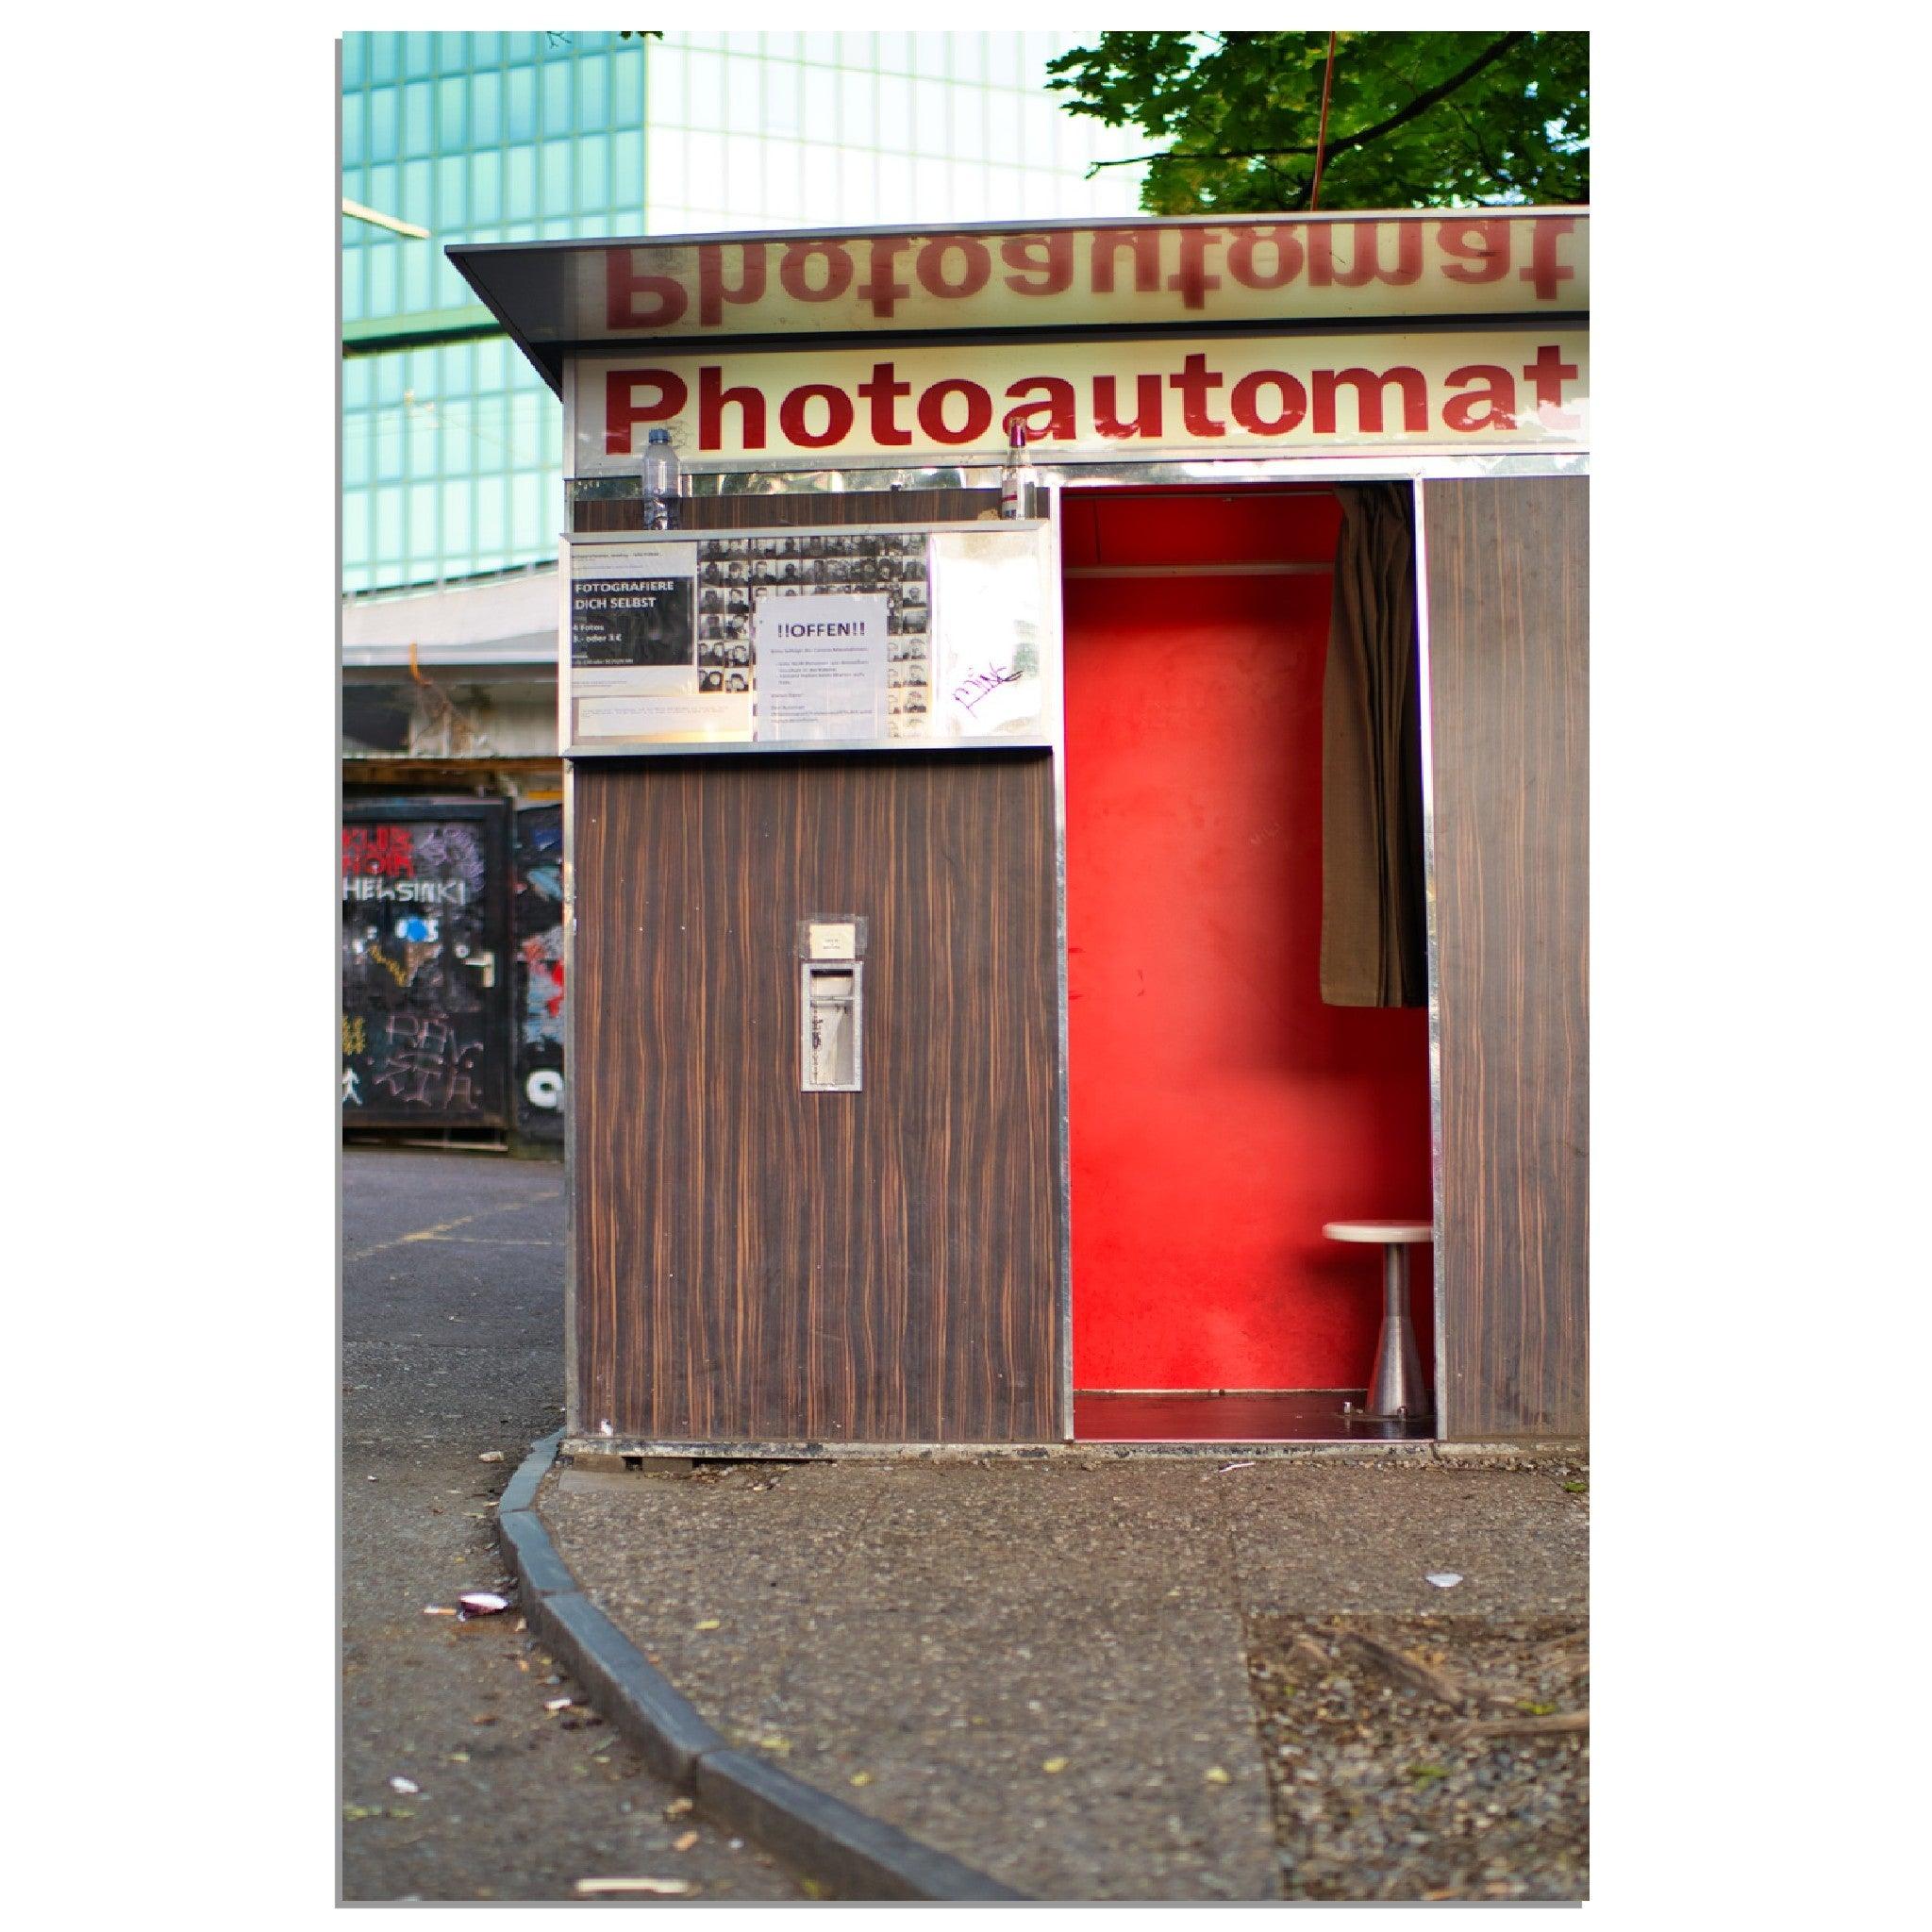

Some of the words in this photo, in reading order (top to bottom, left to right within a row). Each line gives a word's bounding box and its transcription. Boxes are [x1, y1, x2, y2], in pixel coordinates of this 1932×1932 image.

[606, 345, 1581, 456] Photoautomat
[575, 580, 675, 593] FOTOGRAFIERE
[575, 598, 607, 610] DICH
[610, 597, 656, 609] SELBST
[777, 622, 865, 638] !!OFFEN!!
